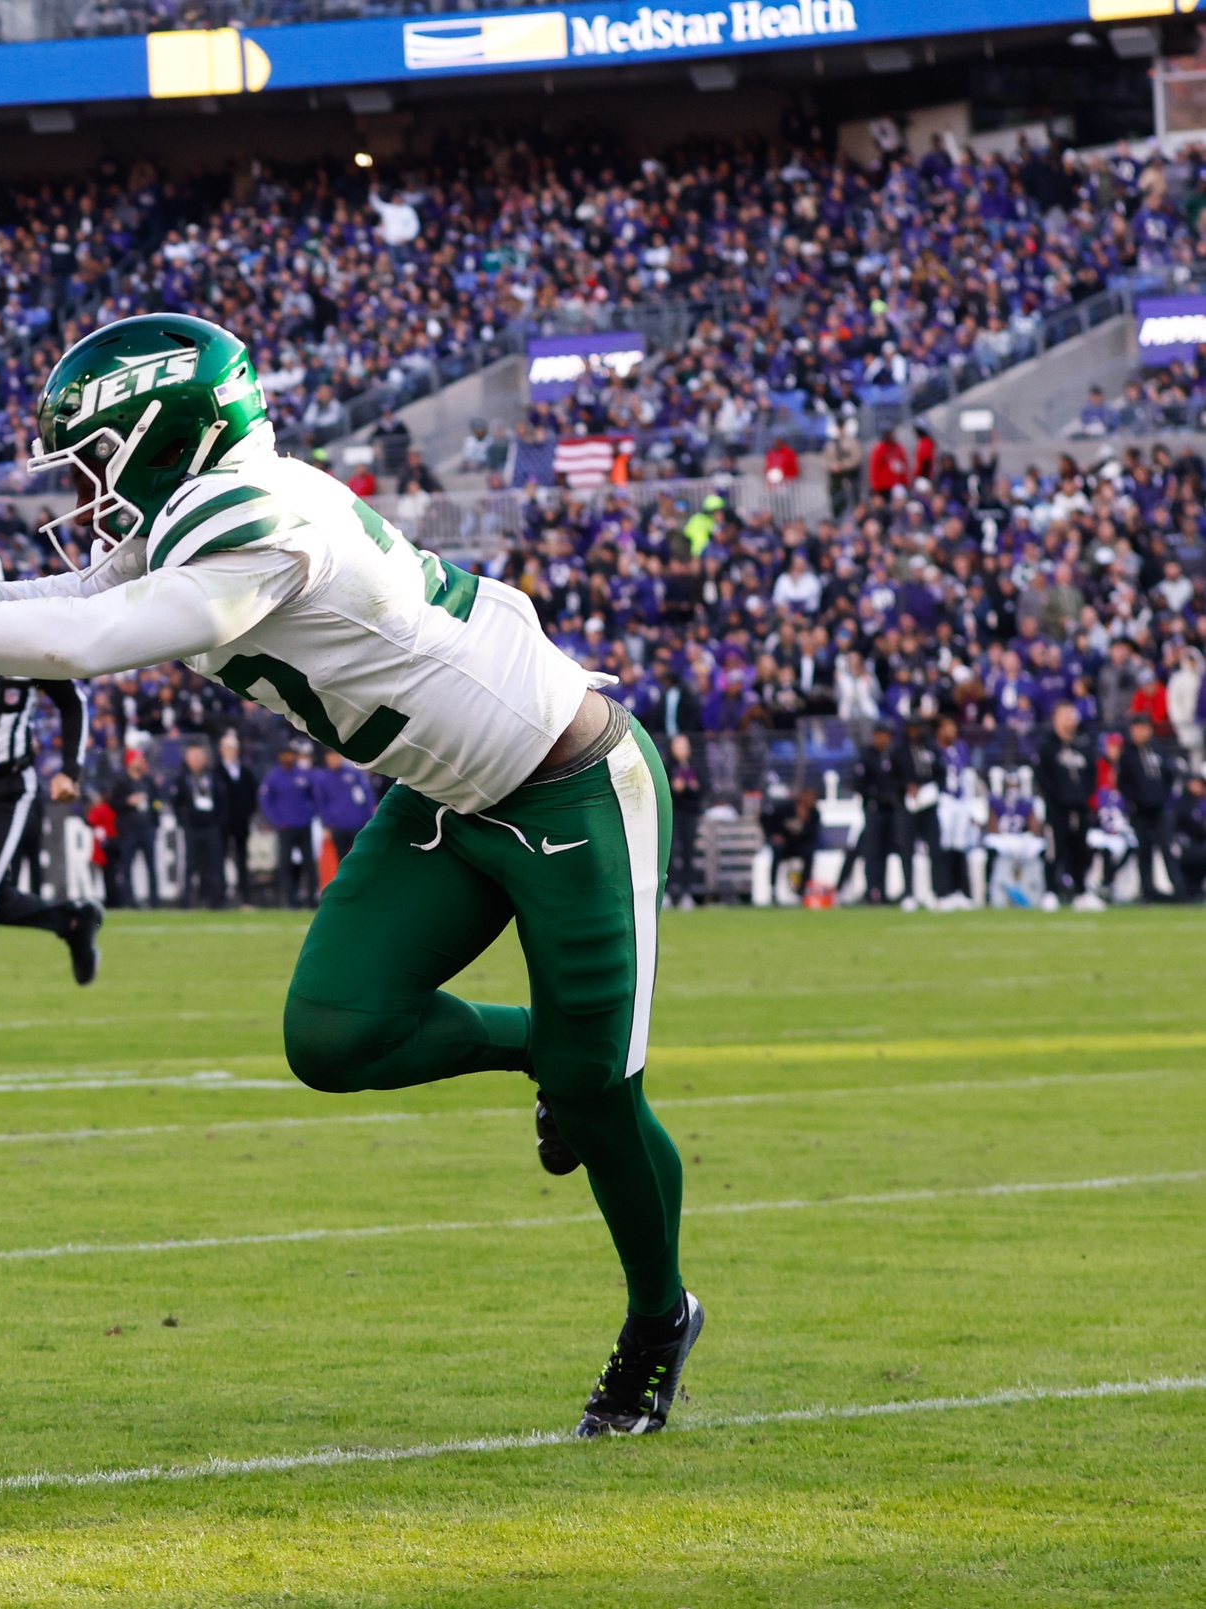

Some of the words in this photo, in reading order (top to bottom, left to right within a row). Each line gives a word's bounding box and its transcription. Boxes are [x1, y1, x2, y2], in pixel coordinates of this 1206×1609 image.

[571, 8, 727, 56] MedStar
[730, 0, 858, 42] Health
[66, 348, 198, 431] JETS
